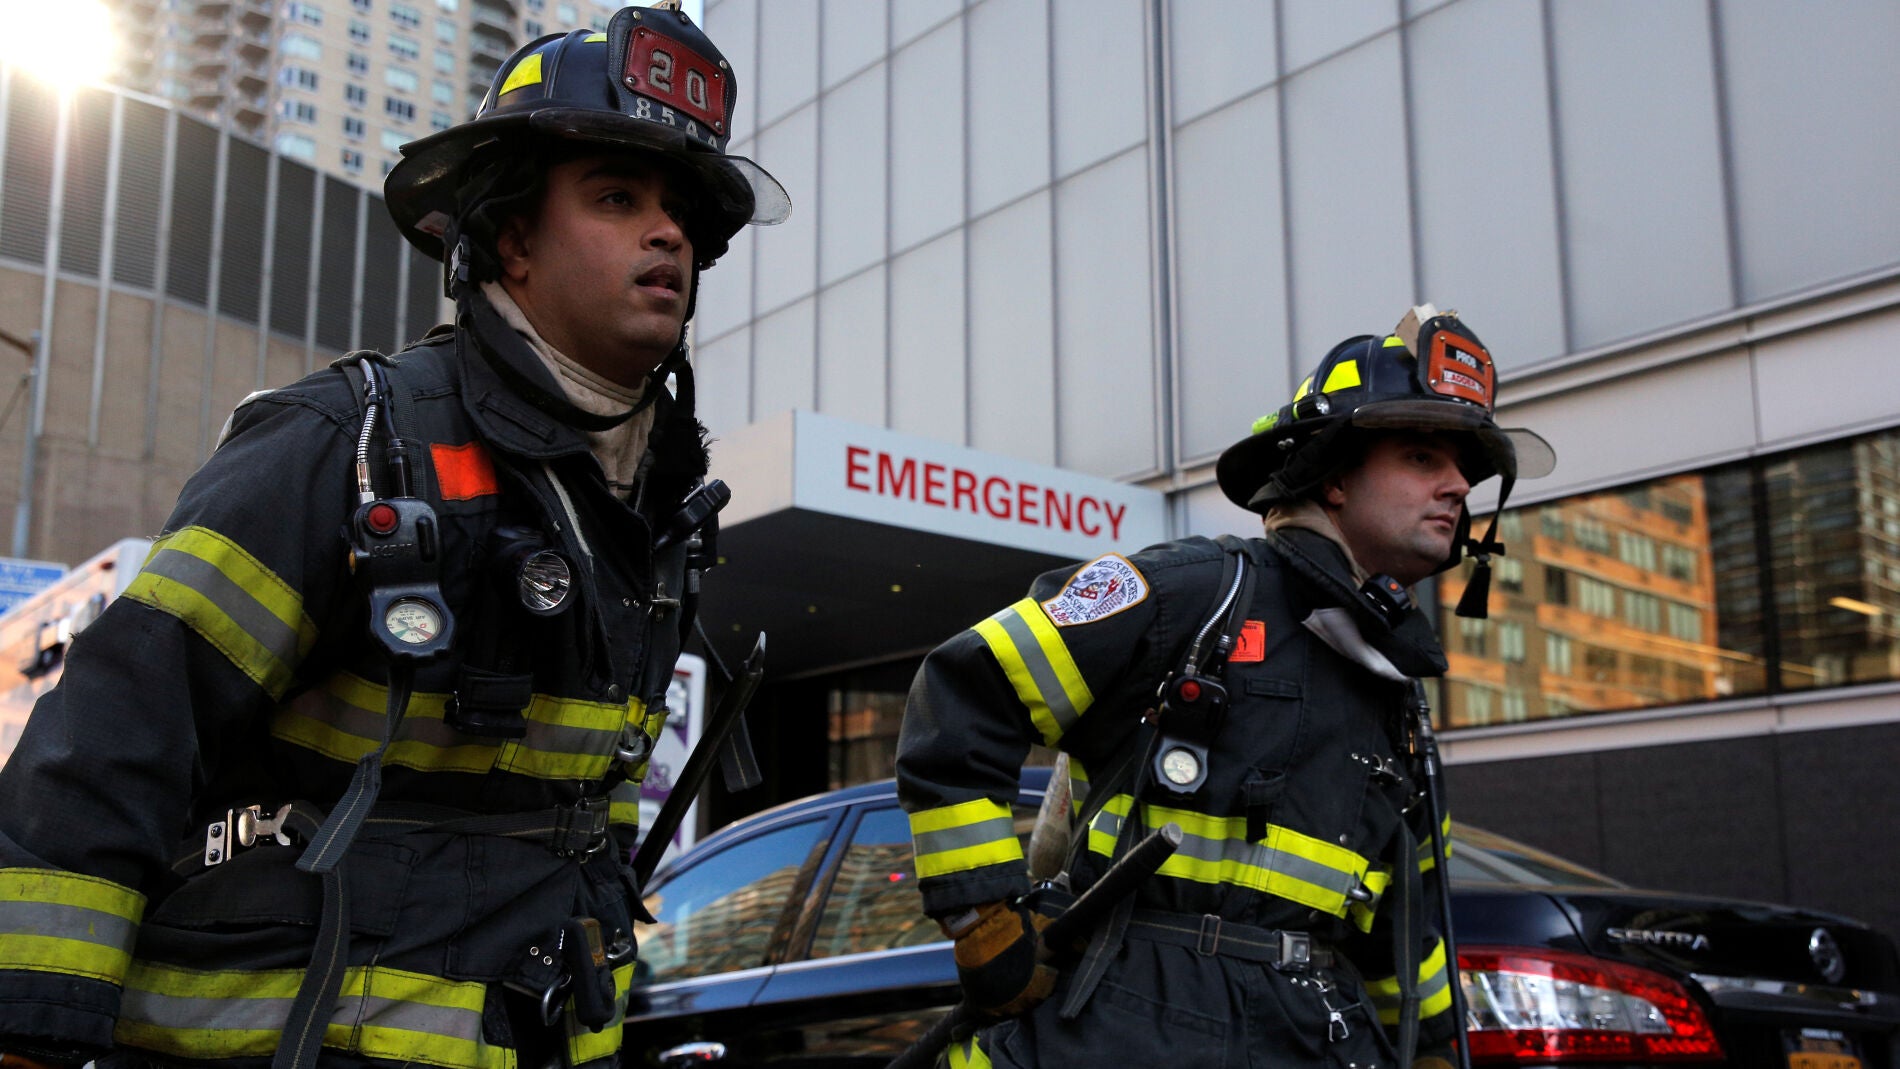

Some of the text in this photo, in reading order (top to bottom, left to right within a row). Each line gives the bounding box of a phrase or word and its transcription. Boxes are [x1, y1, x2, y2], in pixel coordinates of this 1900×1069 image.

[648, 49, 709, 112] 20
[845, 444, 1127, 542] EMERGENCY
[1606, 927, 1711, 950] SENTRA
